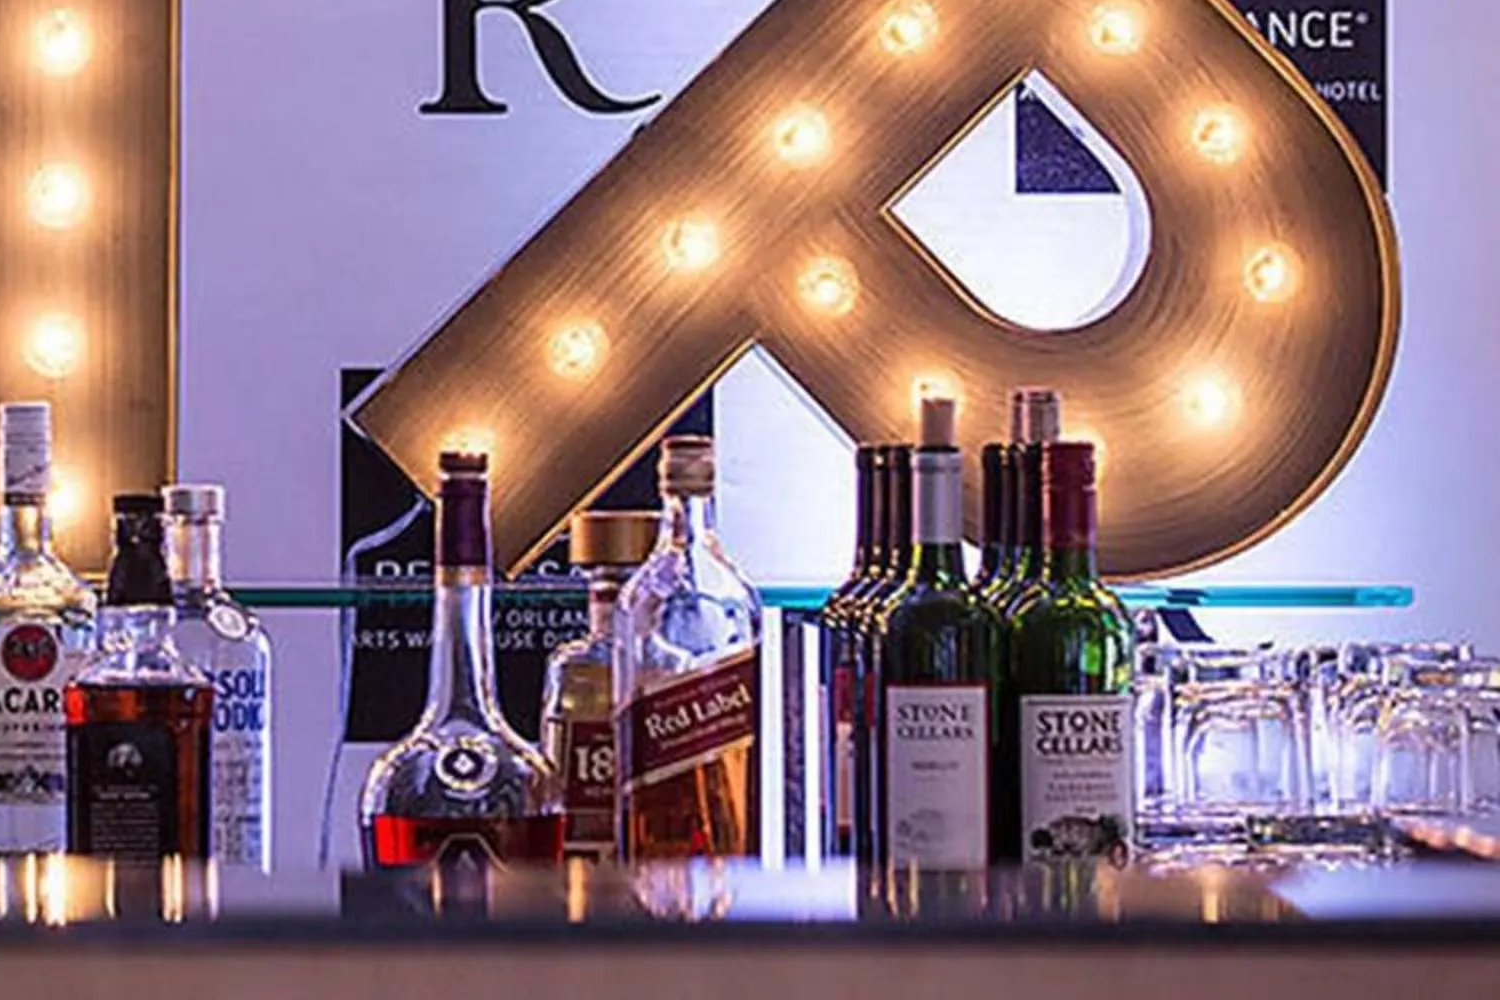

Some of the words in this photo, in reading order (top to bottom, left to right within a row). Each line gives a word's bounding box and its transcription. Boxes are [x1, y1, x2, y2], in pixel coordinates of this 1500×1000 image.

[506, 608, 588, 627] ORLEAN
[214, 701, 264, 732] ODK
[644, 707, 692, 739] Red
[692, 683, 752, 722] Label
[898, 703, 970, 722] STONE
[1037, 710, 1121, 735] STONE
[1036, 736, 1125, 756] CELLARS
